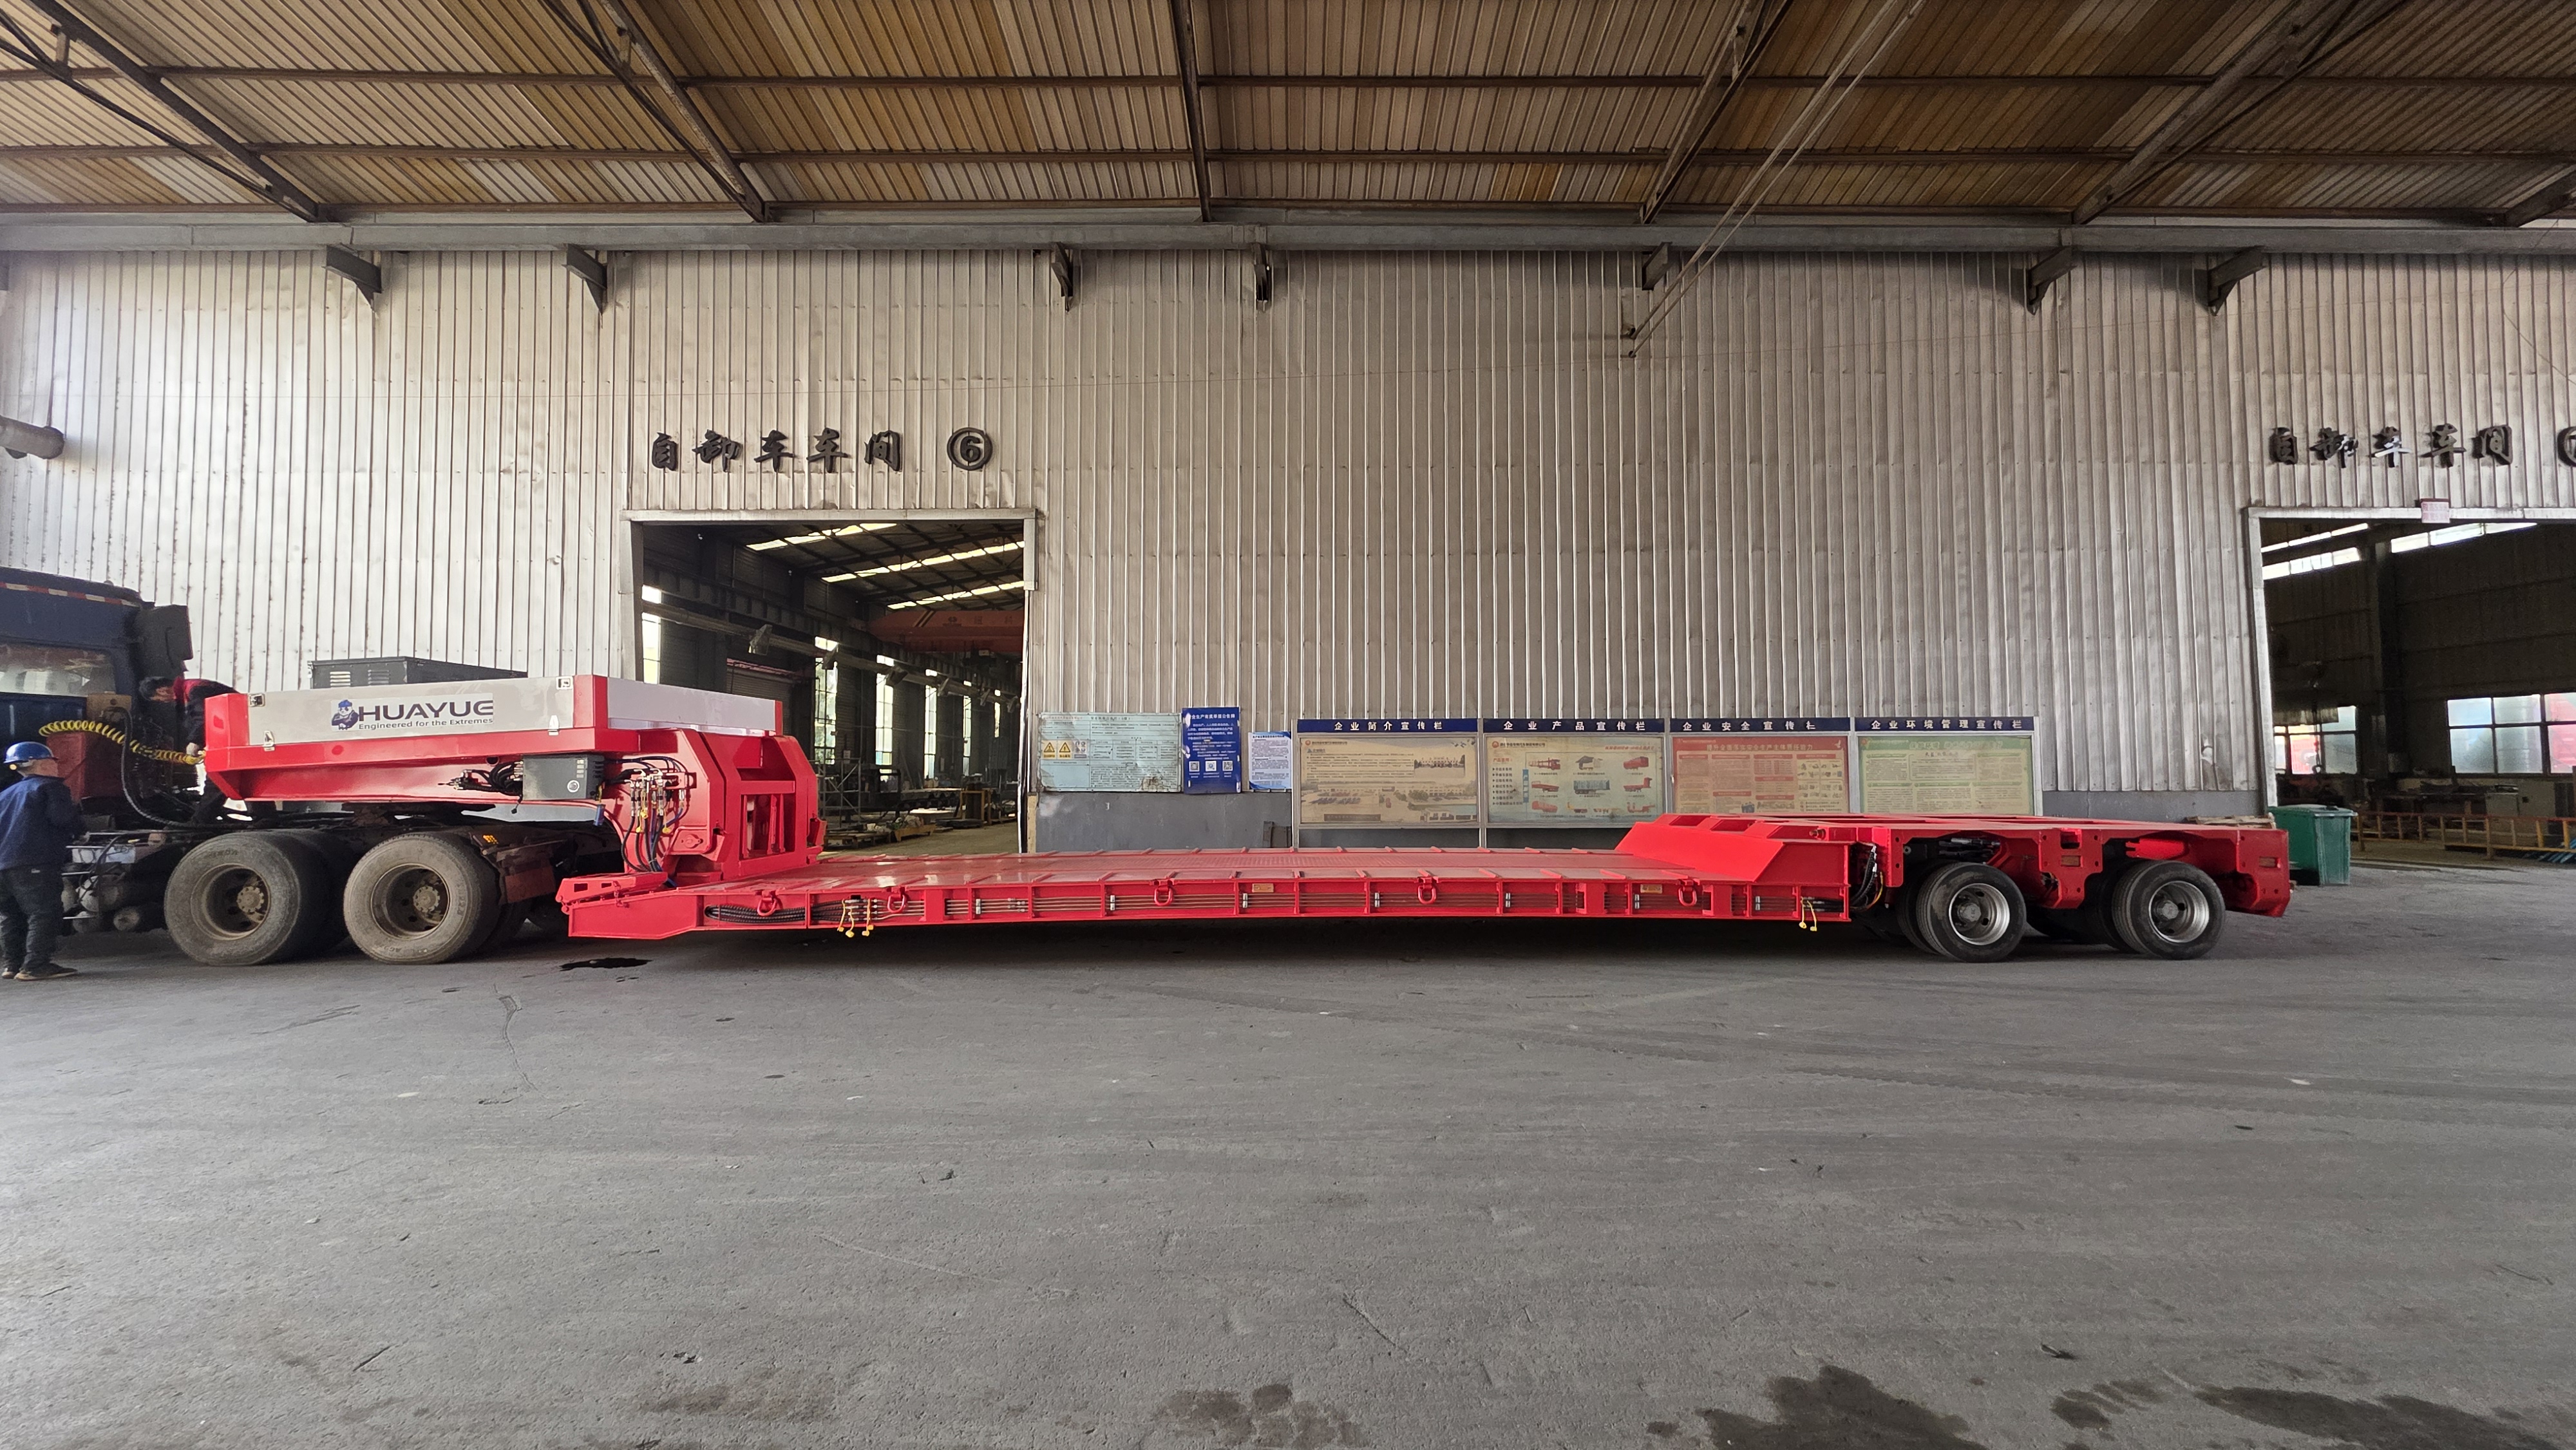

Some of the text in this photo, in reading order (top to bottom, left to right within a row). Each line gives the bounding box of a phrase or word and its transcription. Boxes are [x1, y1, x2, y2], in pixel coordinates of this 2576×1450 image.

[652, 428, 903, 473] 自卸车车间
[359, 700, 493, 722] HUAYUE
[359, 720, 413, 731] Engineered
[450, 717, 493, 726] Extremes
[1334, 721, 1443, 731] 企业简介宣传栏
[1503, 720, 1645, 731] 企业产品宣传栏
[1871, 719, 2022, 730] 企业环境管理宣传栏
